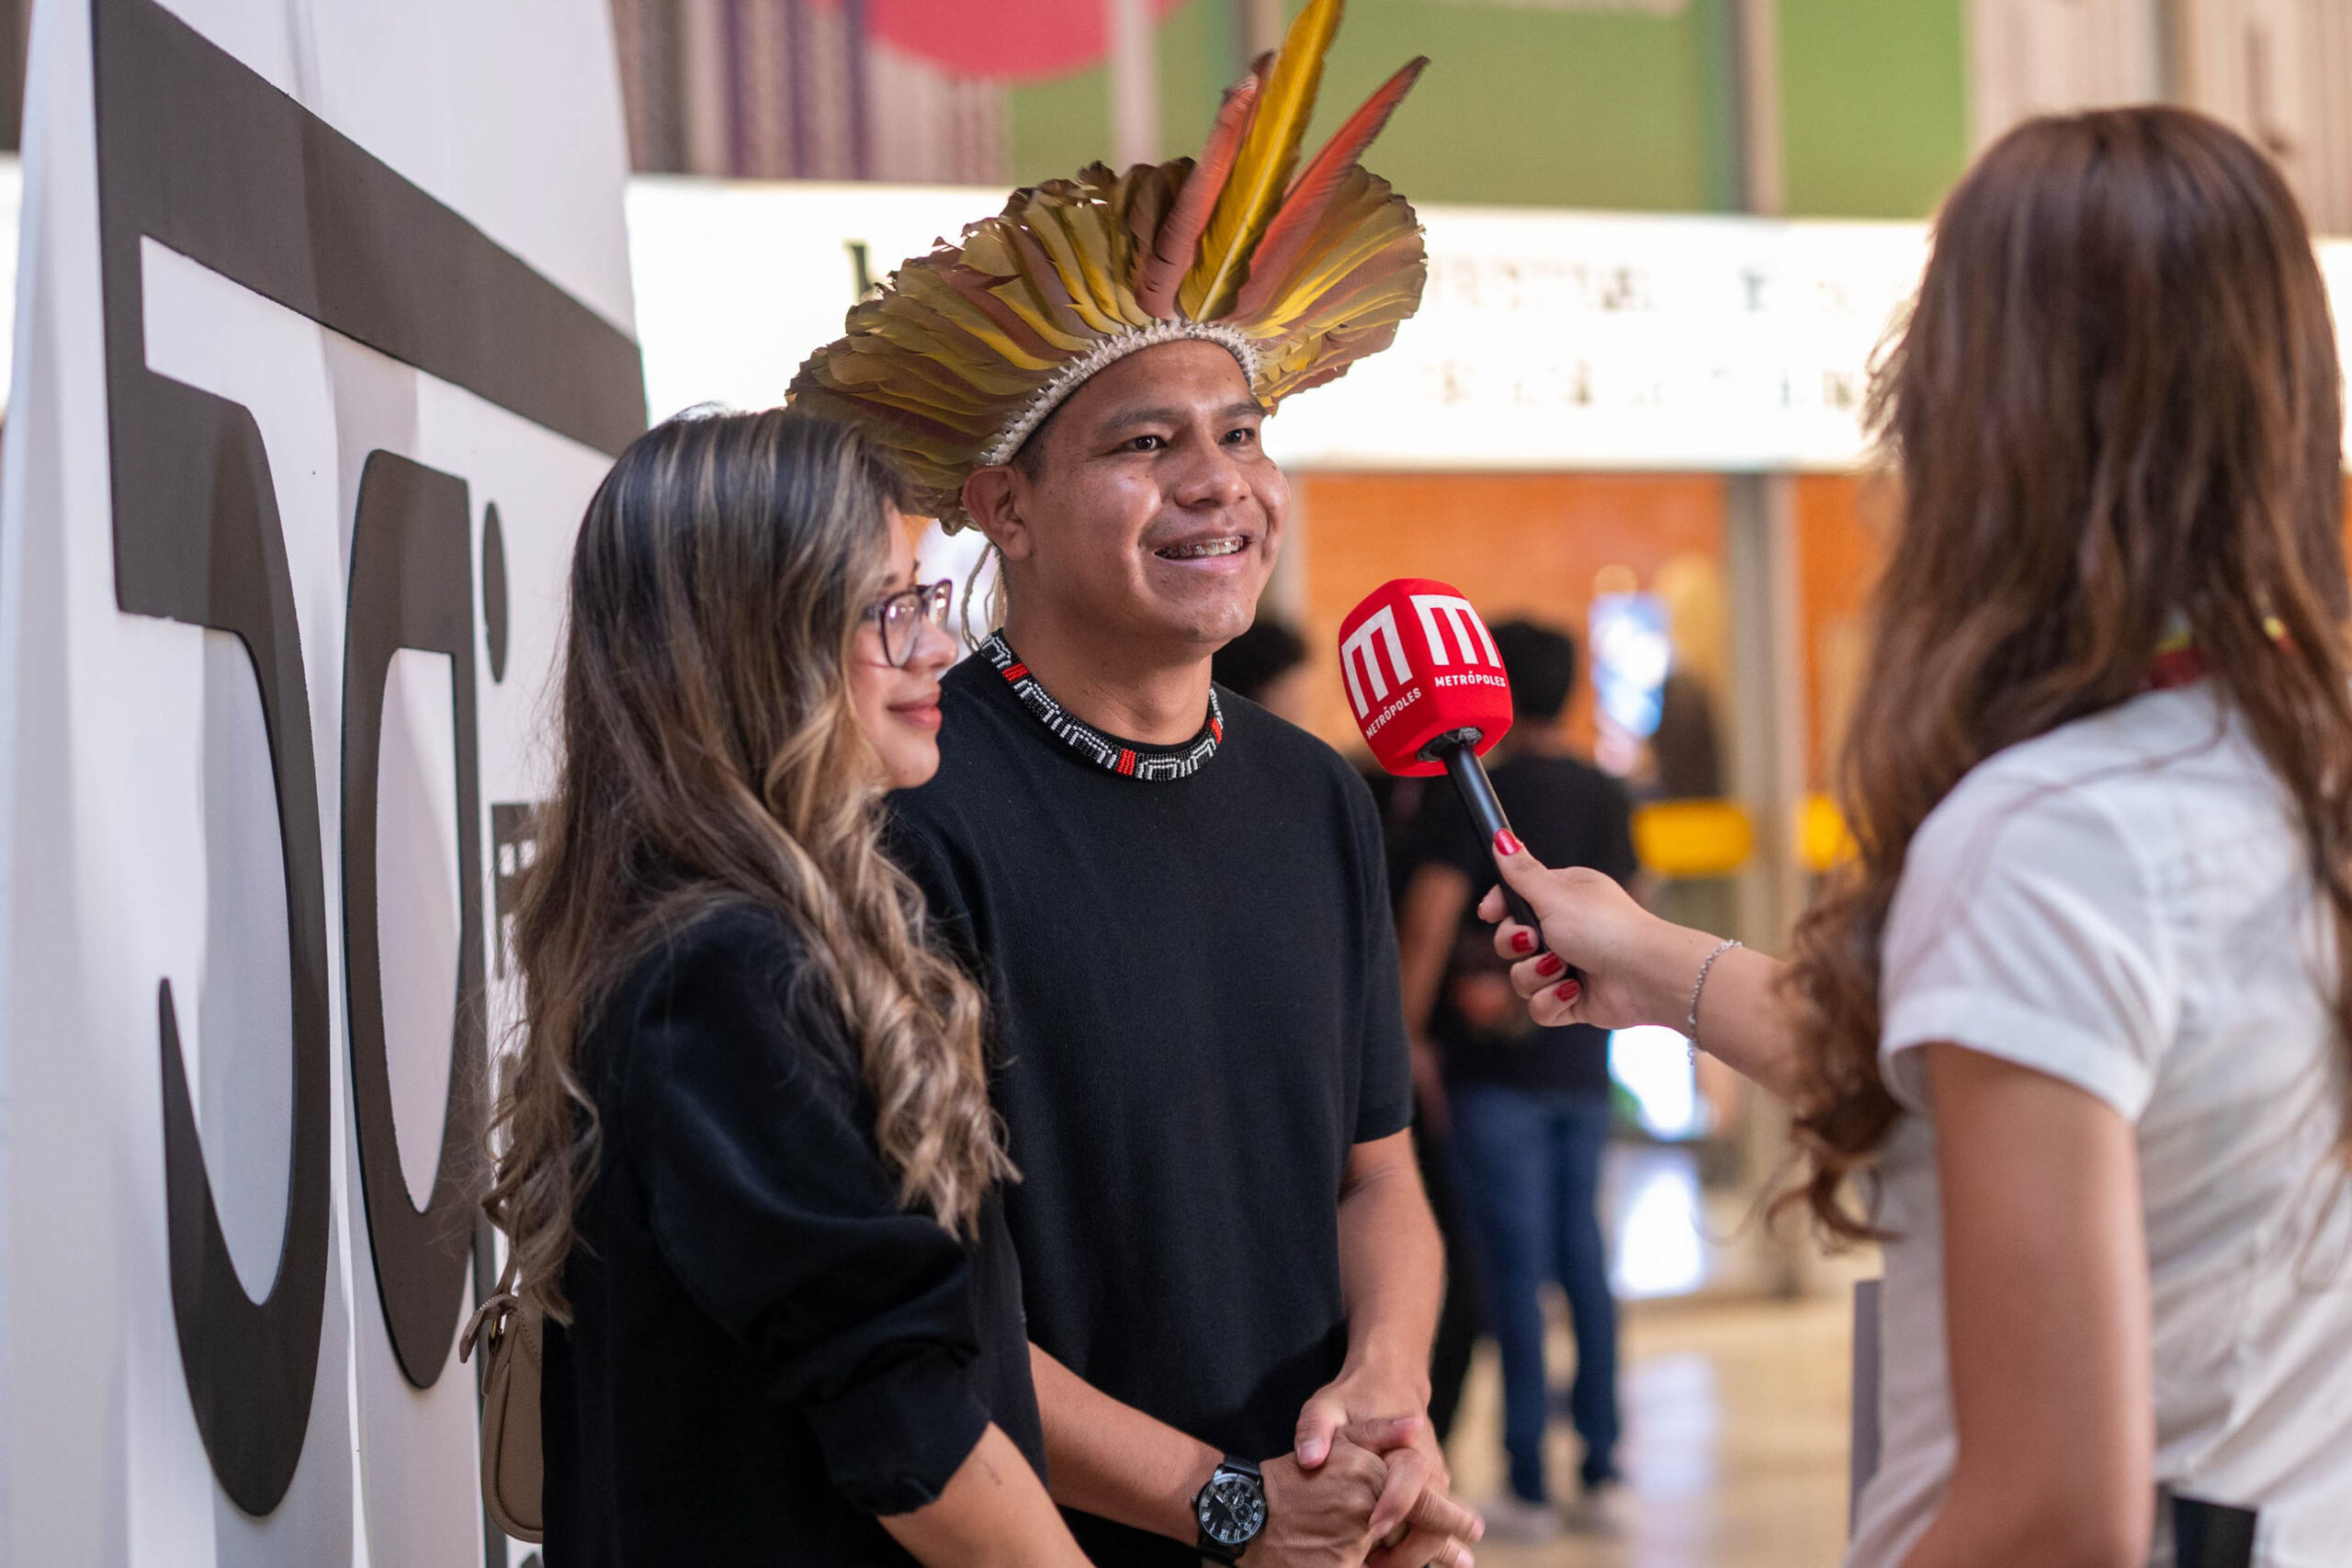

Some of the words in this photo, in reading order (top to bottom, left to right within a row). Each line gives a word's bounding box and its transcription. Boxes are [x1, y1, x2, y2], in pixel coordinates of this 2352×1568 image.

[1340, 604, 1413, 720] M
[1408, 593, 1501, 669] M
[1434, 670, 1507, 687] METRÓPOLES
[1365, 686, 1421, 739] METRÓPOLES
